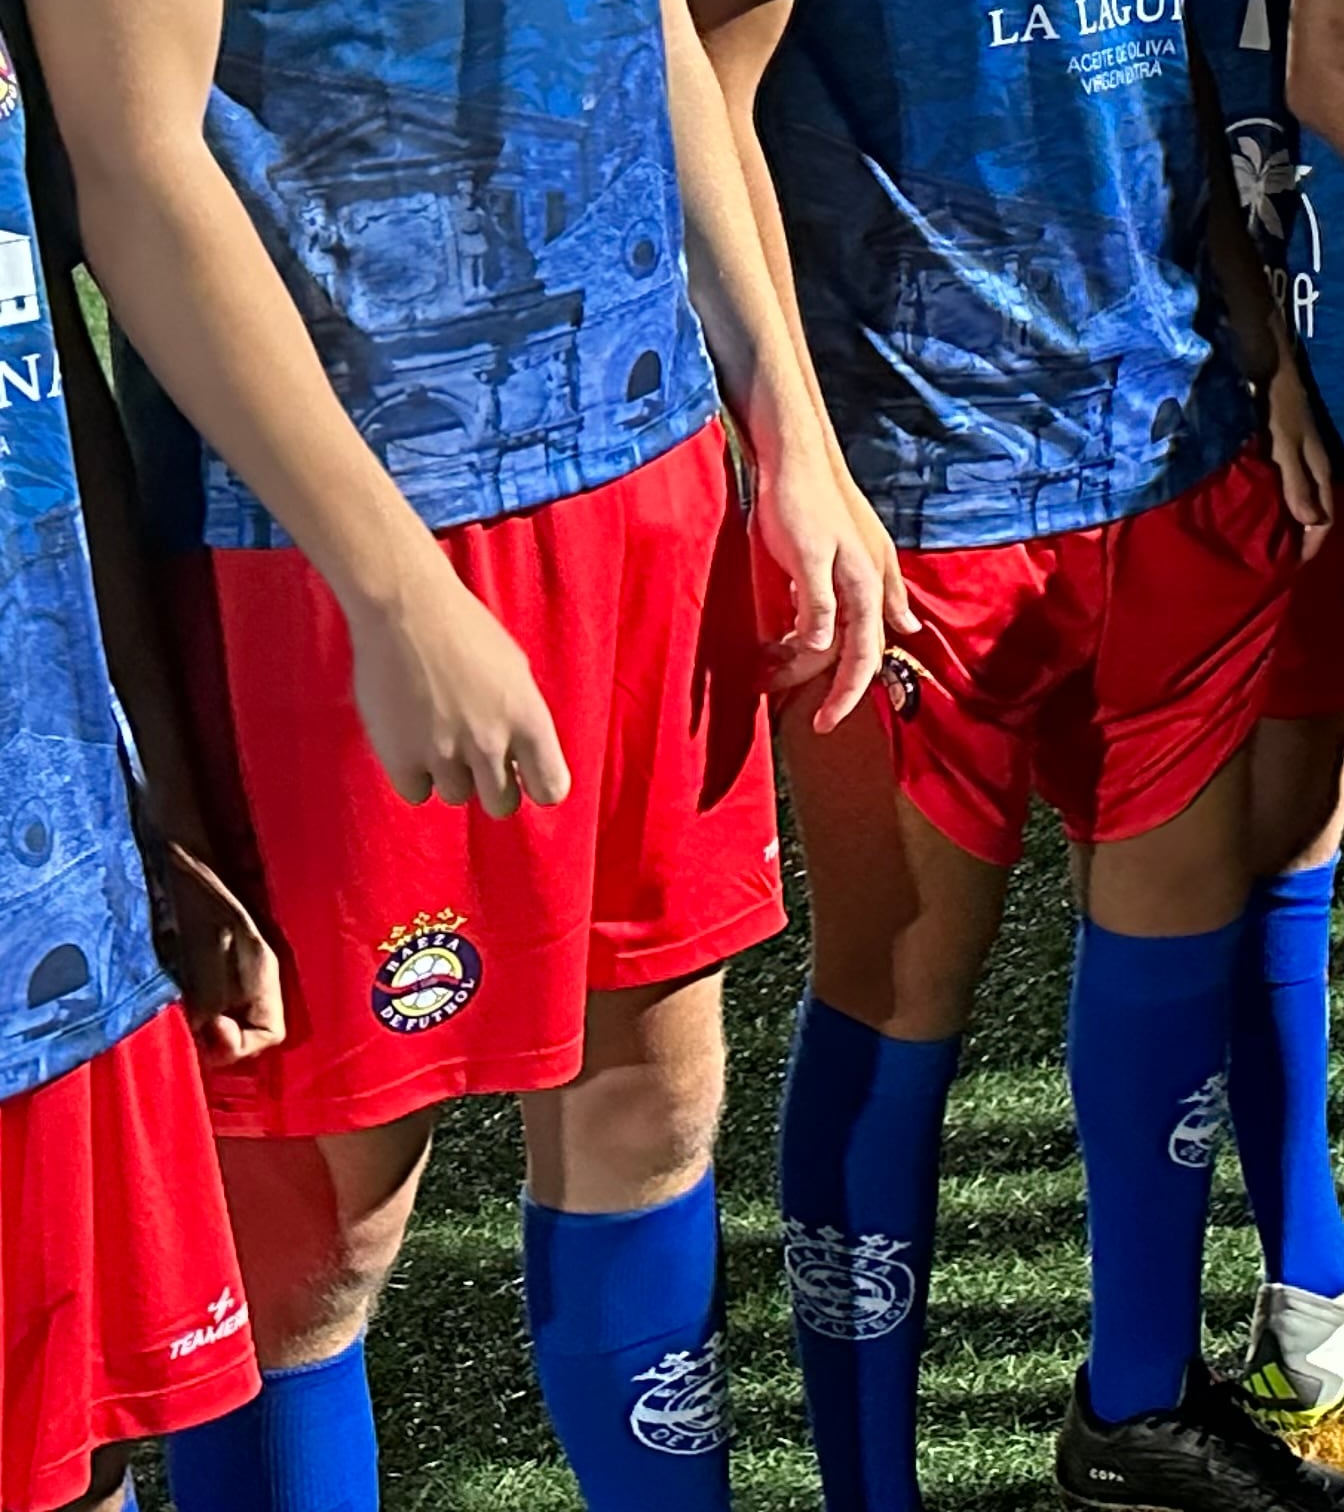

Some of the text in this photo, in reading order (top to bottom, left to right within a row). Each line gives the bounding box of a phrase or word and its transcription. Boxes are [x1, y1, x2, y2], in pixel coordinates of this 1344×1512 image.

[987, 3, 1061, 48] LA
[1128, 38, 1177, 61] OLIVA
[386, 933, 460, 973] BAEZA
[380, 978, 476, 1032] DE FUTBOL
[1089, 1467, 1125, 1483] COPA
